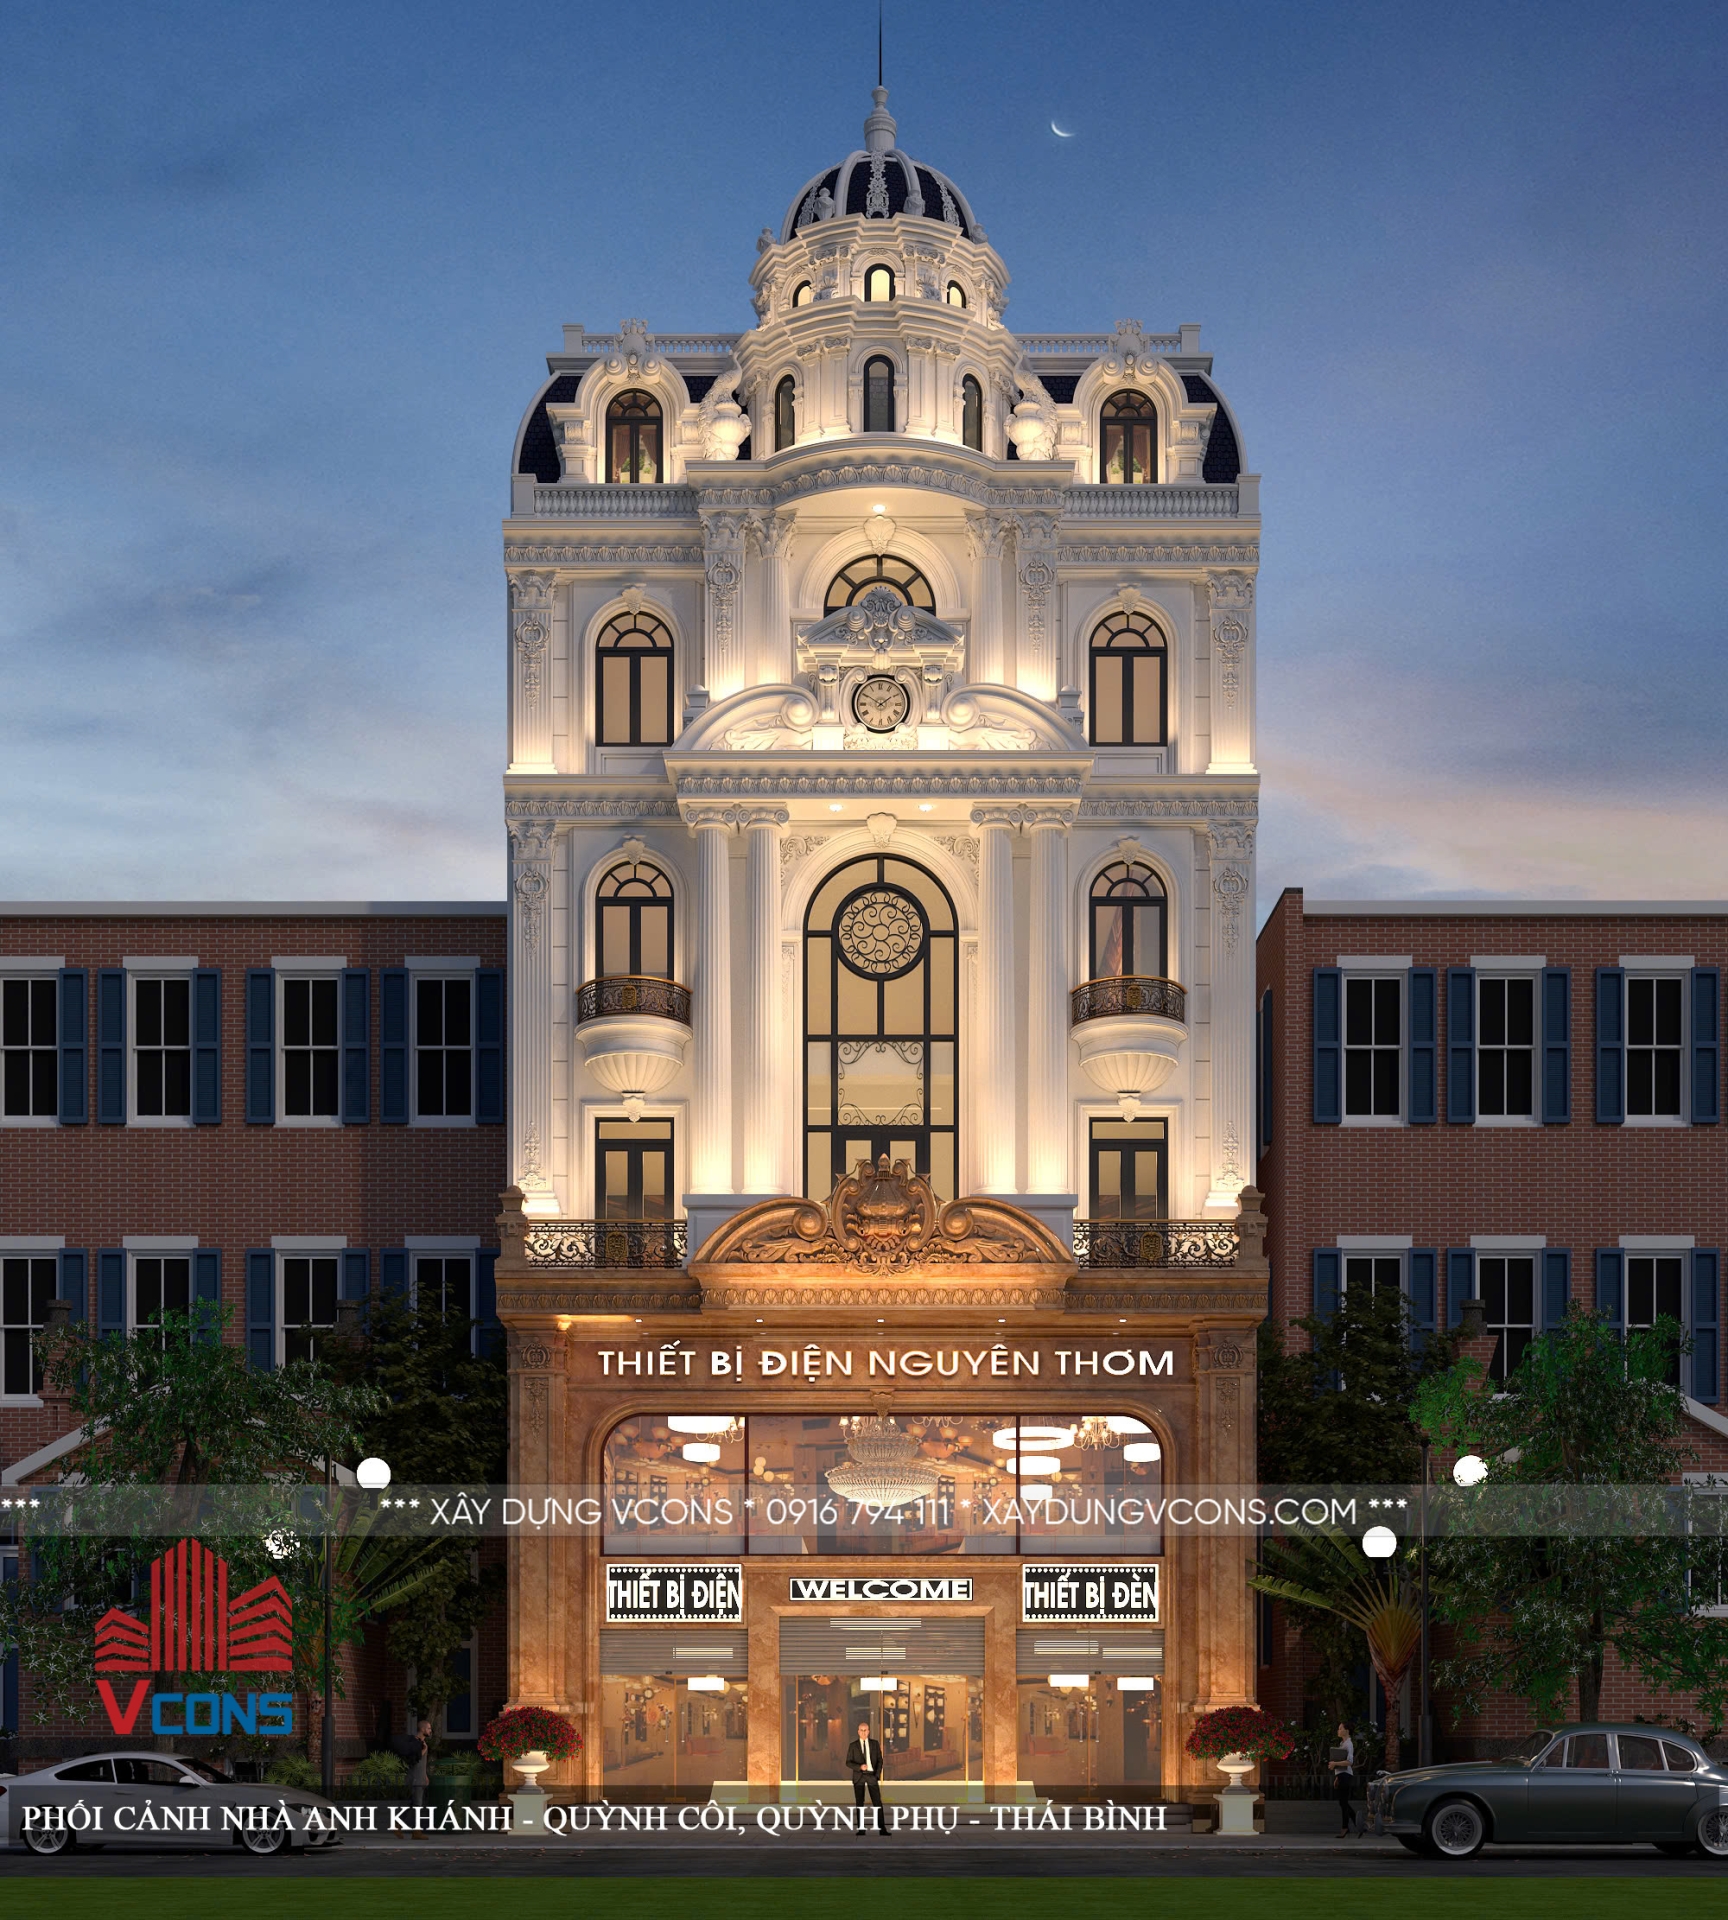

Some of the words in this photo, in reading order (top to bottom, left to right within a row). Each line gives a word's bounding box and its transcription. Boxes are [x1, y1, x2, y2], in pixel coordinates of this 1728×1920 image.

[598, 1340, 696, 1376] THIẾT
[711, 1345, 743, 1383] BỊ
[758, 1343, 852, 1383] ĐIỆN
[869, 1343, 1040, 1376] NGUYÊN
[1055, 1349, 1174, 1376] THƠM
[608, 1568, 661, 1609] THIẾT
[666, 1573, 685, 1616] BỊ
[690, 1572, 742, 1616] ĐIỆN
[796, 1579, 968, 1599] WELCOME
[1025, 1570, 1080, 1609] THIẾT
[1085, 1575, 1105, 1615] BỊ
[1111, 1572, 1158, 1609] ĐÈN
